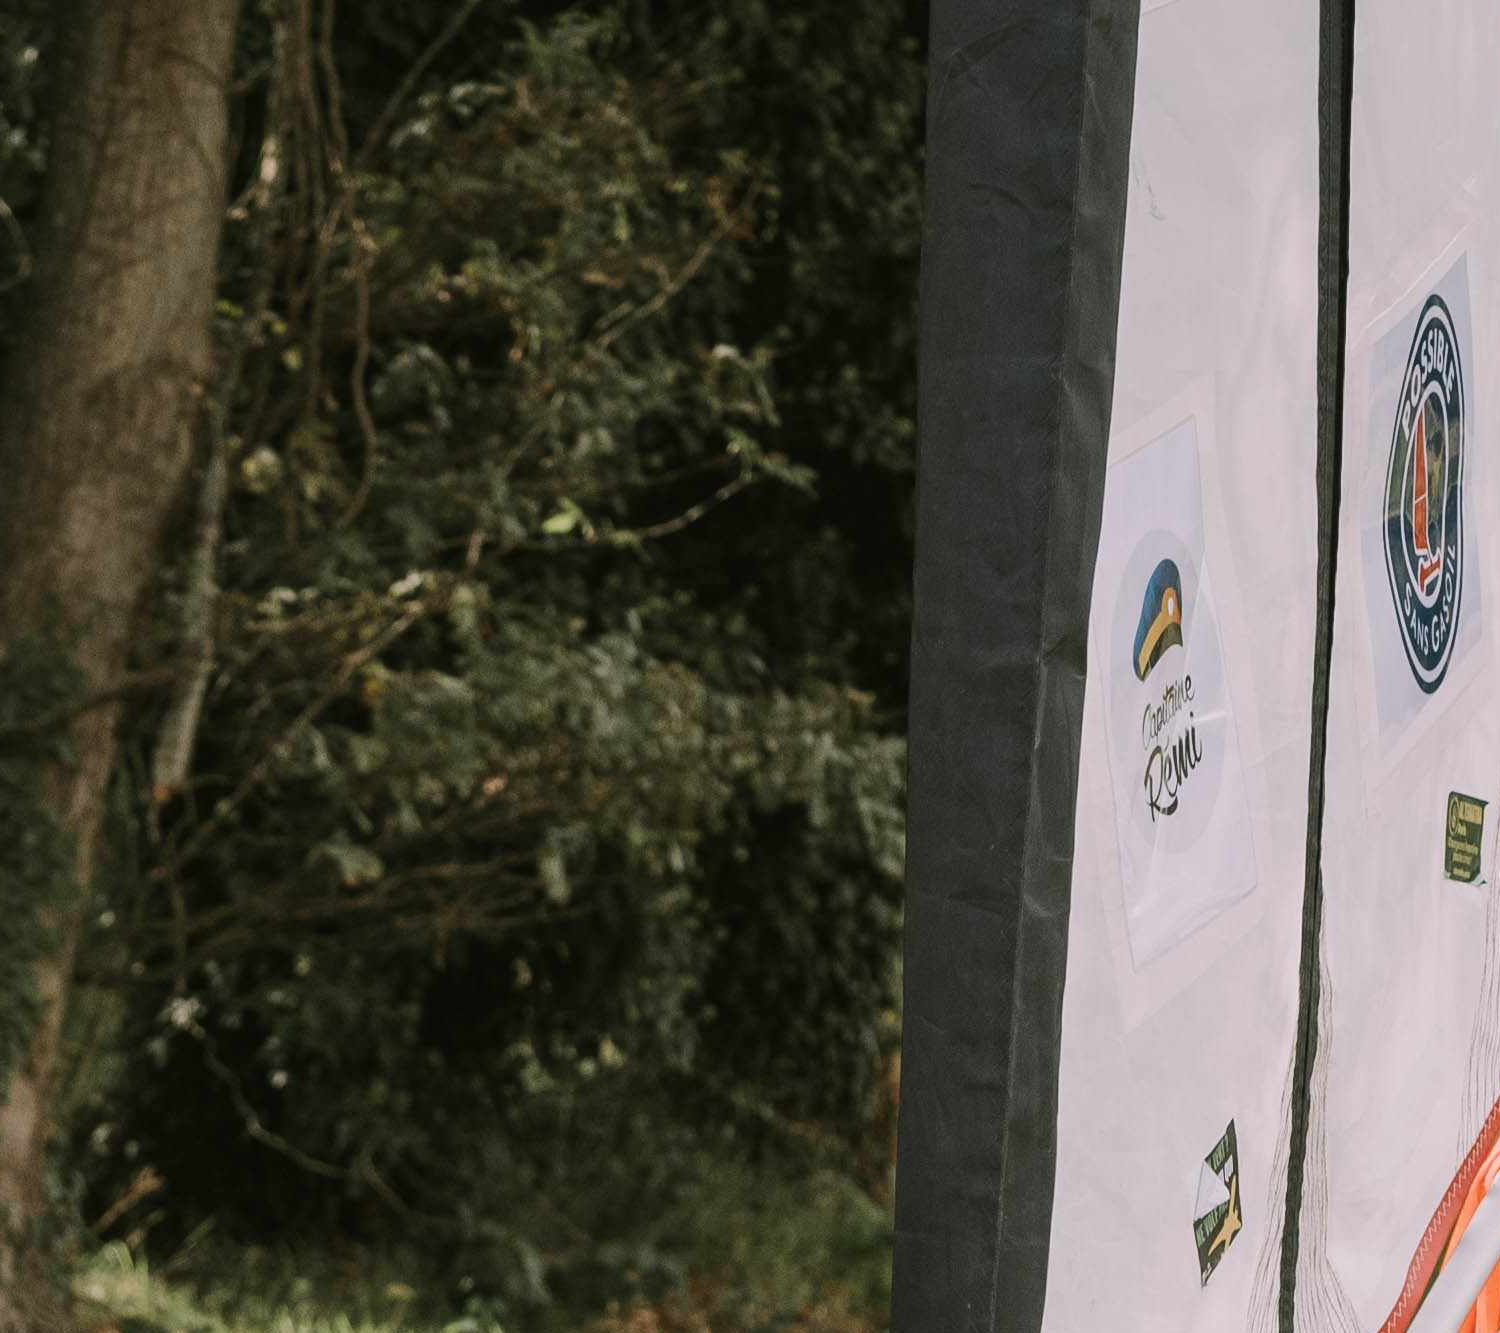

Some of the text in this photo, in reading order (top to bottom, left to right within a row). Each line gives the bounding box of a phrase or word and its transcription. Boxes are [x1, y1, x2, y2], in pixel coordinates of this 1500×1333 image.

[1402, 328, 1455, 441] POSSIBLE
[1404, 544, 1456, 656] SANS GASOIL
[1142, 674, 1195, 751] Capitaine
[1144, 711, 1203, 823] Rémi
